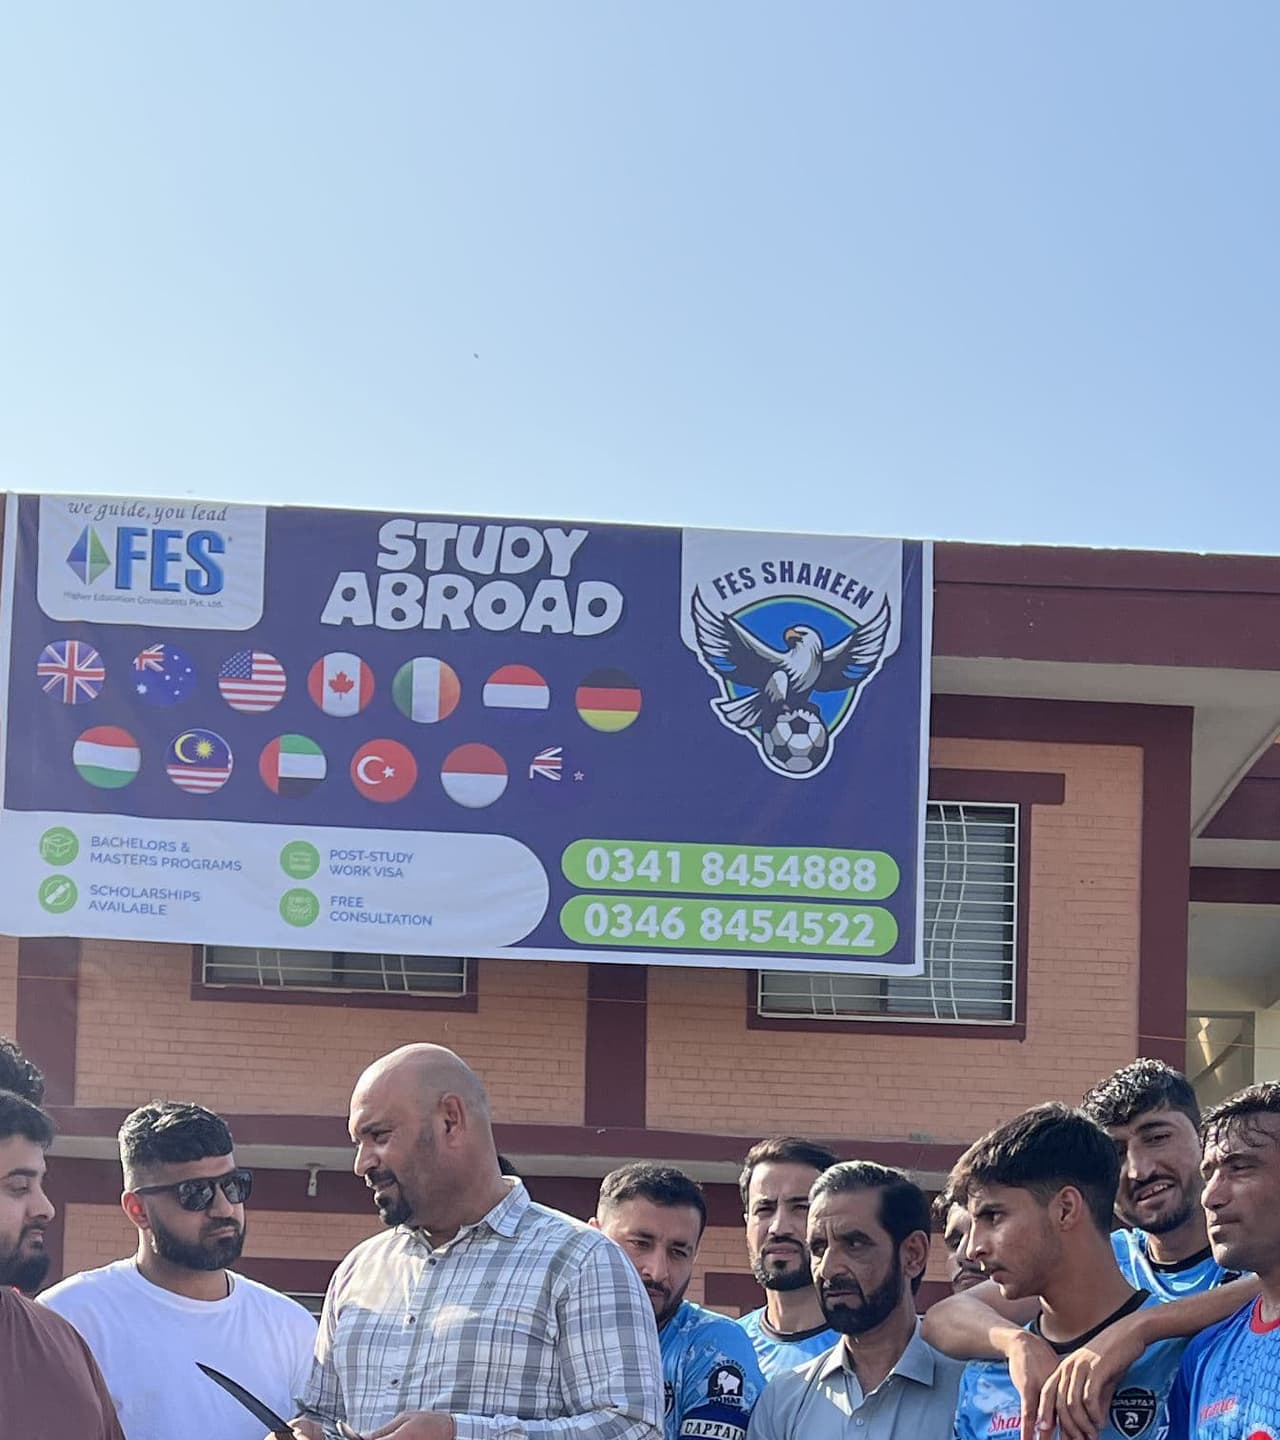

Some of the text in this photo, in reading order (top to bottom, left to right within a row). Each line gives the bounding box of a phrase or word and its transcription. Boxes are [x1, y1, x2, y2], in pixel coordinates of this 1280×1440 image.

[192, 503, 227, 522] lead
[376, 519, 589, 577] STUDY
[115, 526, 226, 596] FES
[711, 560, 875, 610] FES SHAHEEN
[320, 571, 624, 636] ABROAD
[91, 835, 191, 853] BACHELORS &
[89, 852, 243, 872] MASTERS PROGRAMS
[329, 849, 415, 864] POST-STUDY
[329, 864, 405, 879] WORK VISA
[585, 846, 877, 892] 0341 8454888
[89, 884, 202, 903] SCHOLARSHIPS
[330, 895, 365, 908] FREE
[88, 900, 169, 916] AVAILABLE
[329, 911, 433, 926] CONSULTATION
[583, 902, 876, 948] 0346 8454522
[988, 1413, 1022, 1433] Sha
